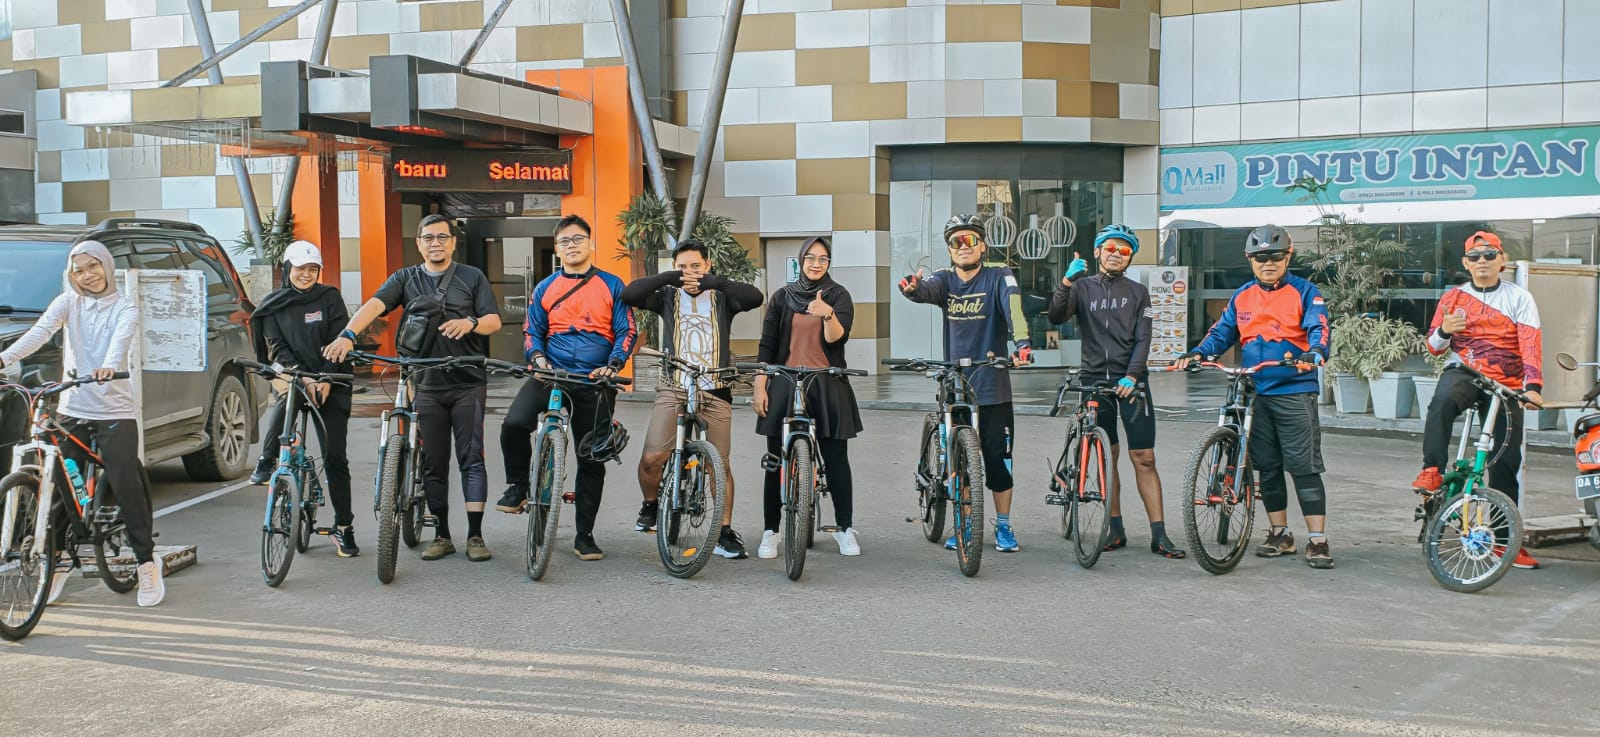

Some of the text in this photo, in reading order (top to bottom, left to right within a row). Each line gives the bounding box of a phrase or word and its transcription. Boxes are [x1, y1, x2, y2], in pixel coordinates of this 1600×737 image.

[489, 161, 569, 180] Selamat
[1244, 140, 1588, 188] PINTU INTAN
[1090, 297, 1128, 312] MAAP
[1578, 477, 1591, 487] DA
